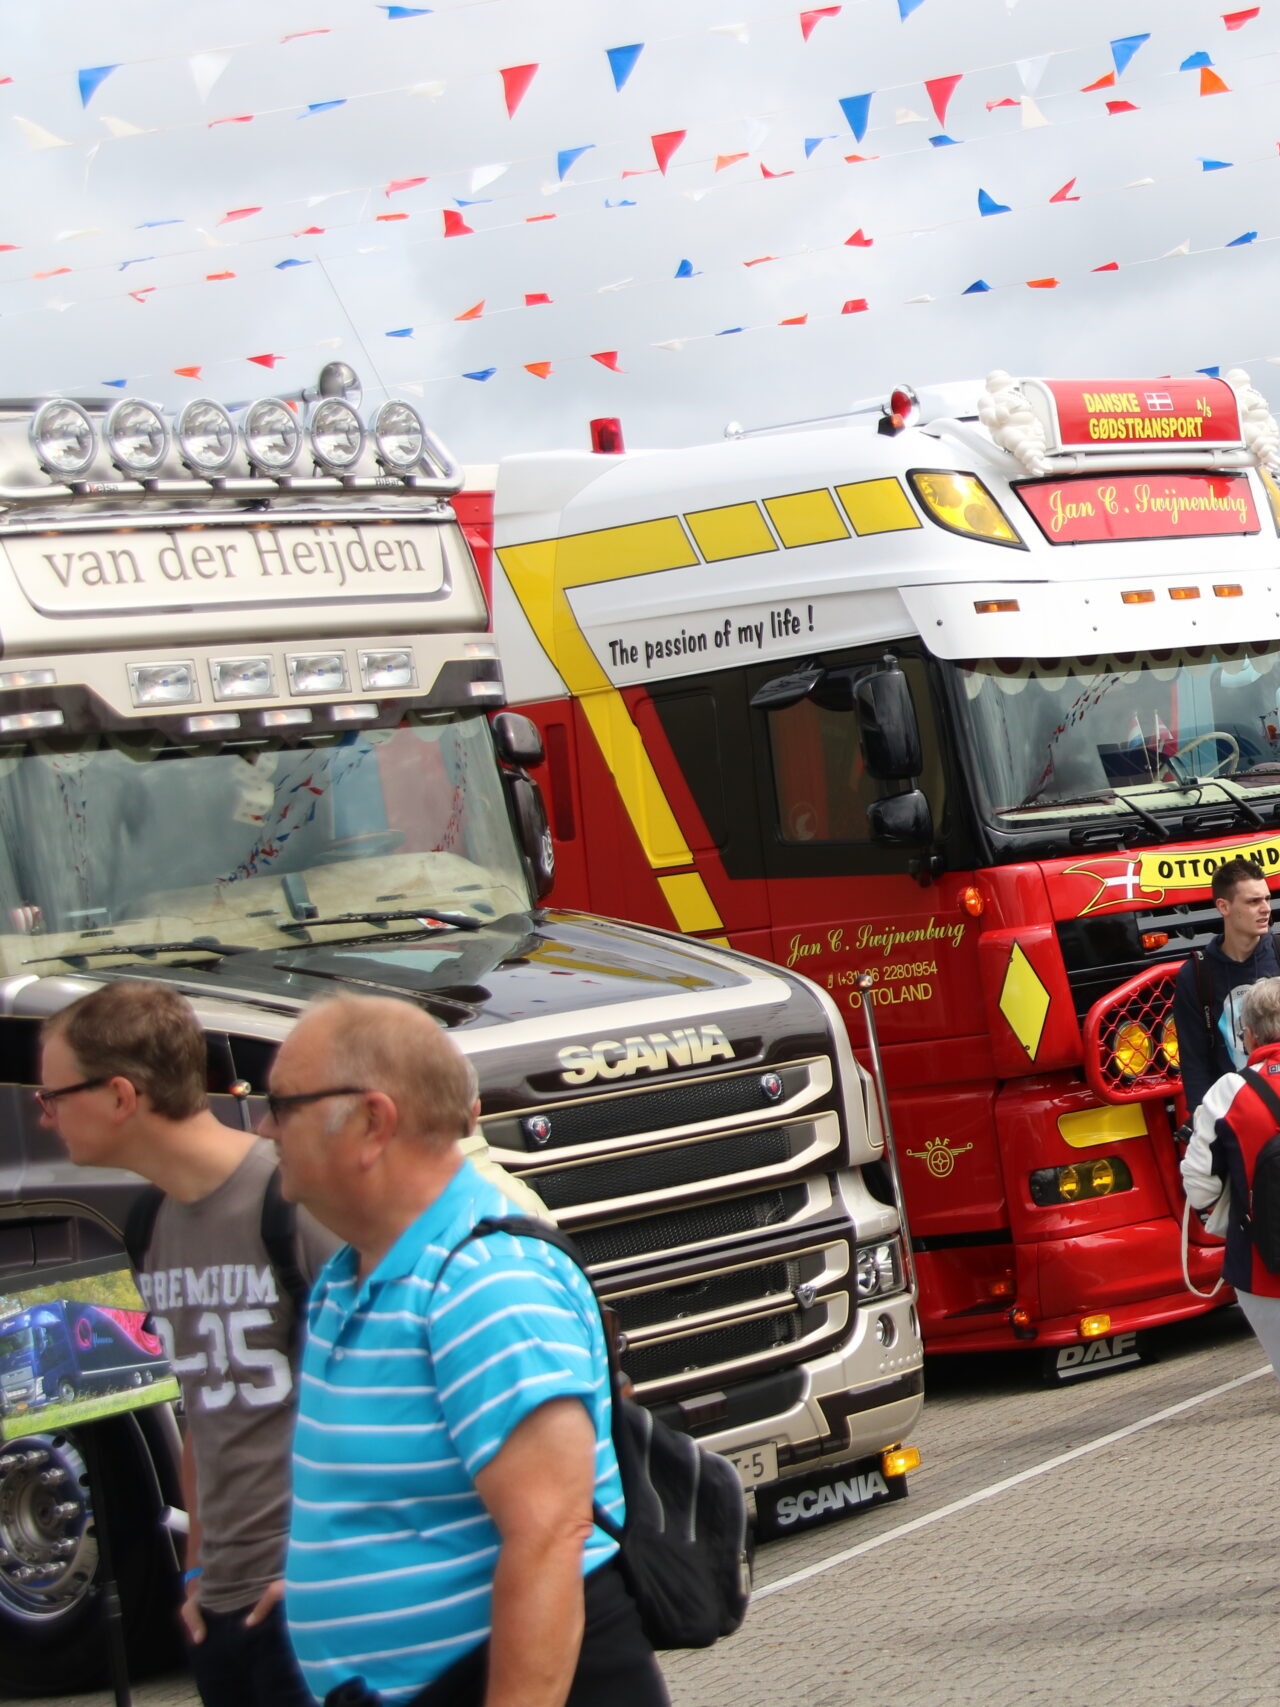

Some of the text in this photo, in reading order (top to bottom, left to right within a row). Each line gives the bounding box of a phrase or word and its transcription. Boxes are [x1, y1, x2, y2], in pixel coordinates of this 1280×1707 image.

[1082, 393, 1141, 413] DANSKE
[1196, 397, 1212, 418] A/S
[1089, 417, 1203, 439] GØDSTRANSPORT
[1049, 489, 1095, 532] Jan
[1134, 484, 1247, 524] Swijnenburg
[43, 527, 426, 588] van der Heijden
[608, 639, 639, 667] The
[645, 629, 708, 669] passion
[714, 618, 732, 648] of
[738, 620, 764, 649] my
[770, 607, 801, 639] life
[1158, 848, 1280, 878] OTTOND
[787, 934, 822, 967] Jan
[856, 917, 965, 956] Swijnenburg
[883, 960, 938, 981] 22801954
[849, 983, 932, 1008] OTOLAND
[558, 1024, 736, 1085] SCANIA
[924, 1137, 950, 1148] DAF
[139, 1264, 279, 1310] PREMIUM
[776, 1470, 889, 1526] SCANIA
